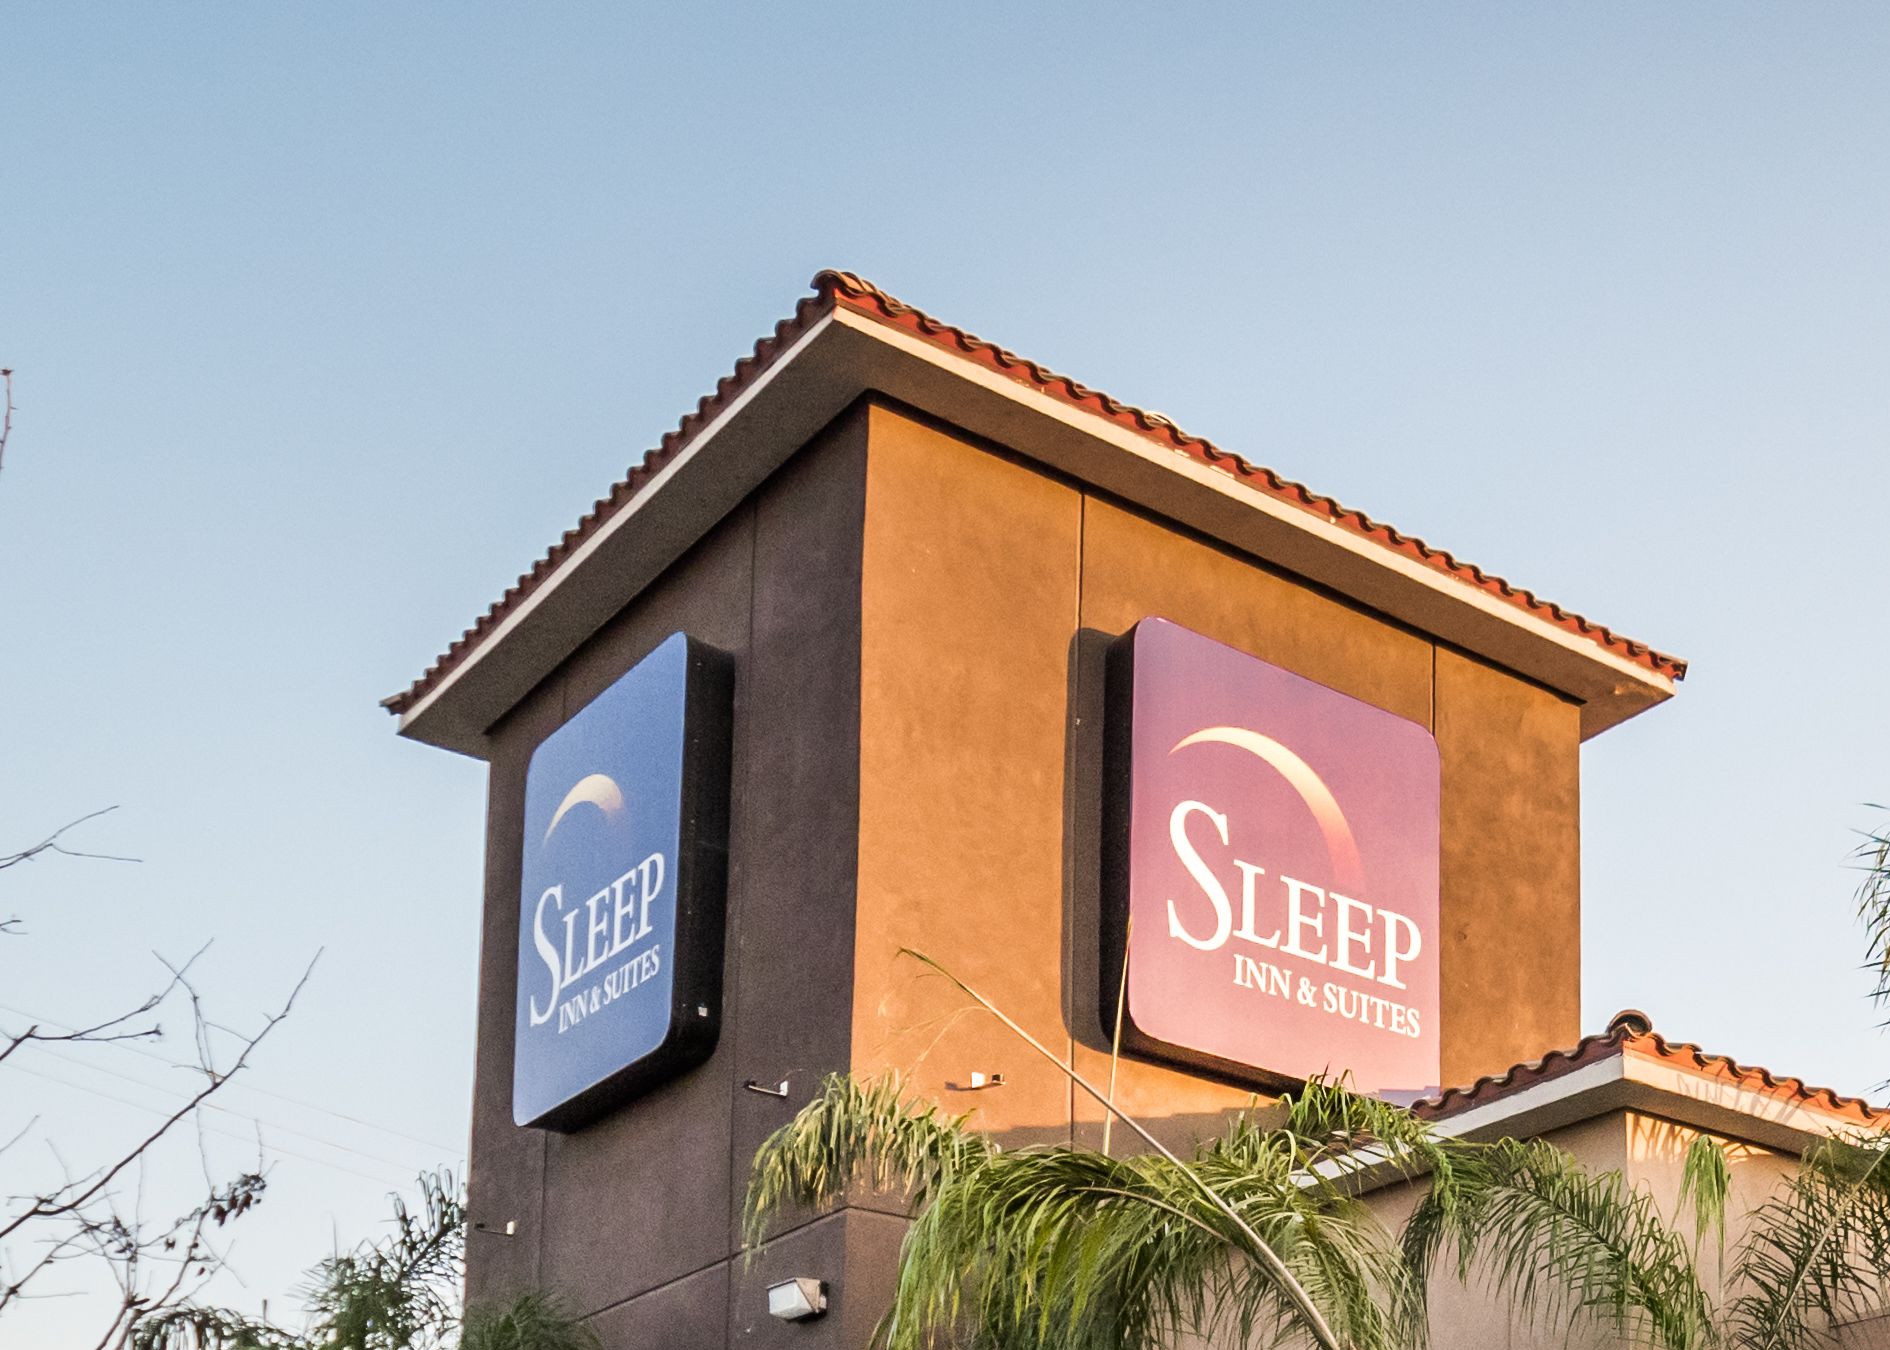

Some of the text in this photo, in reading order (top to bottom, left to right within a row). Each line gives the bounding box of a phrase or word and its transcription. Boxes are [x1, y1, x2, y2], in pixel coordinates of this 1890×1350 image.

[529, 852, 665, 1028] SLEEP
[1167, 800, 1422, 990] SLEEP
[557, 944, 660, 1035] INN & SUITES
[1232, 953, 1421, 1039] INN & SUITES
